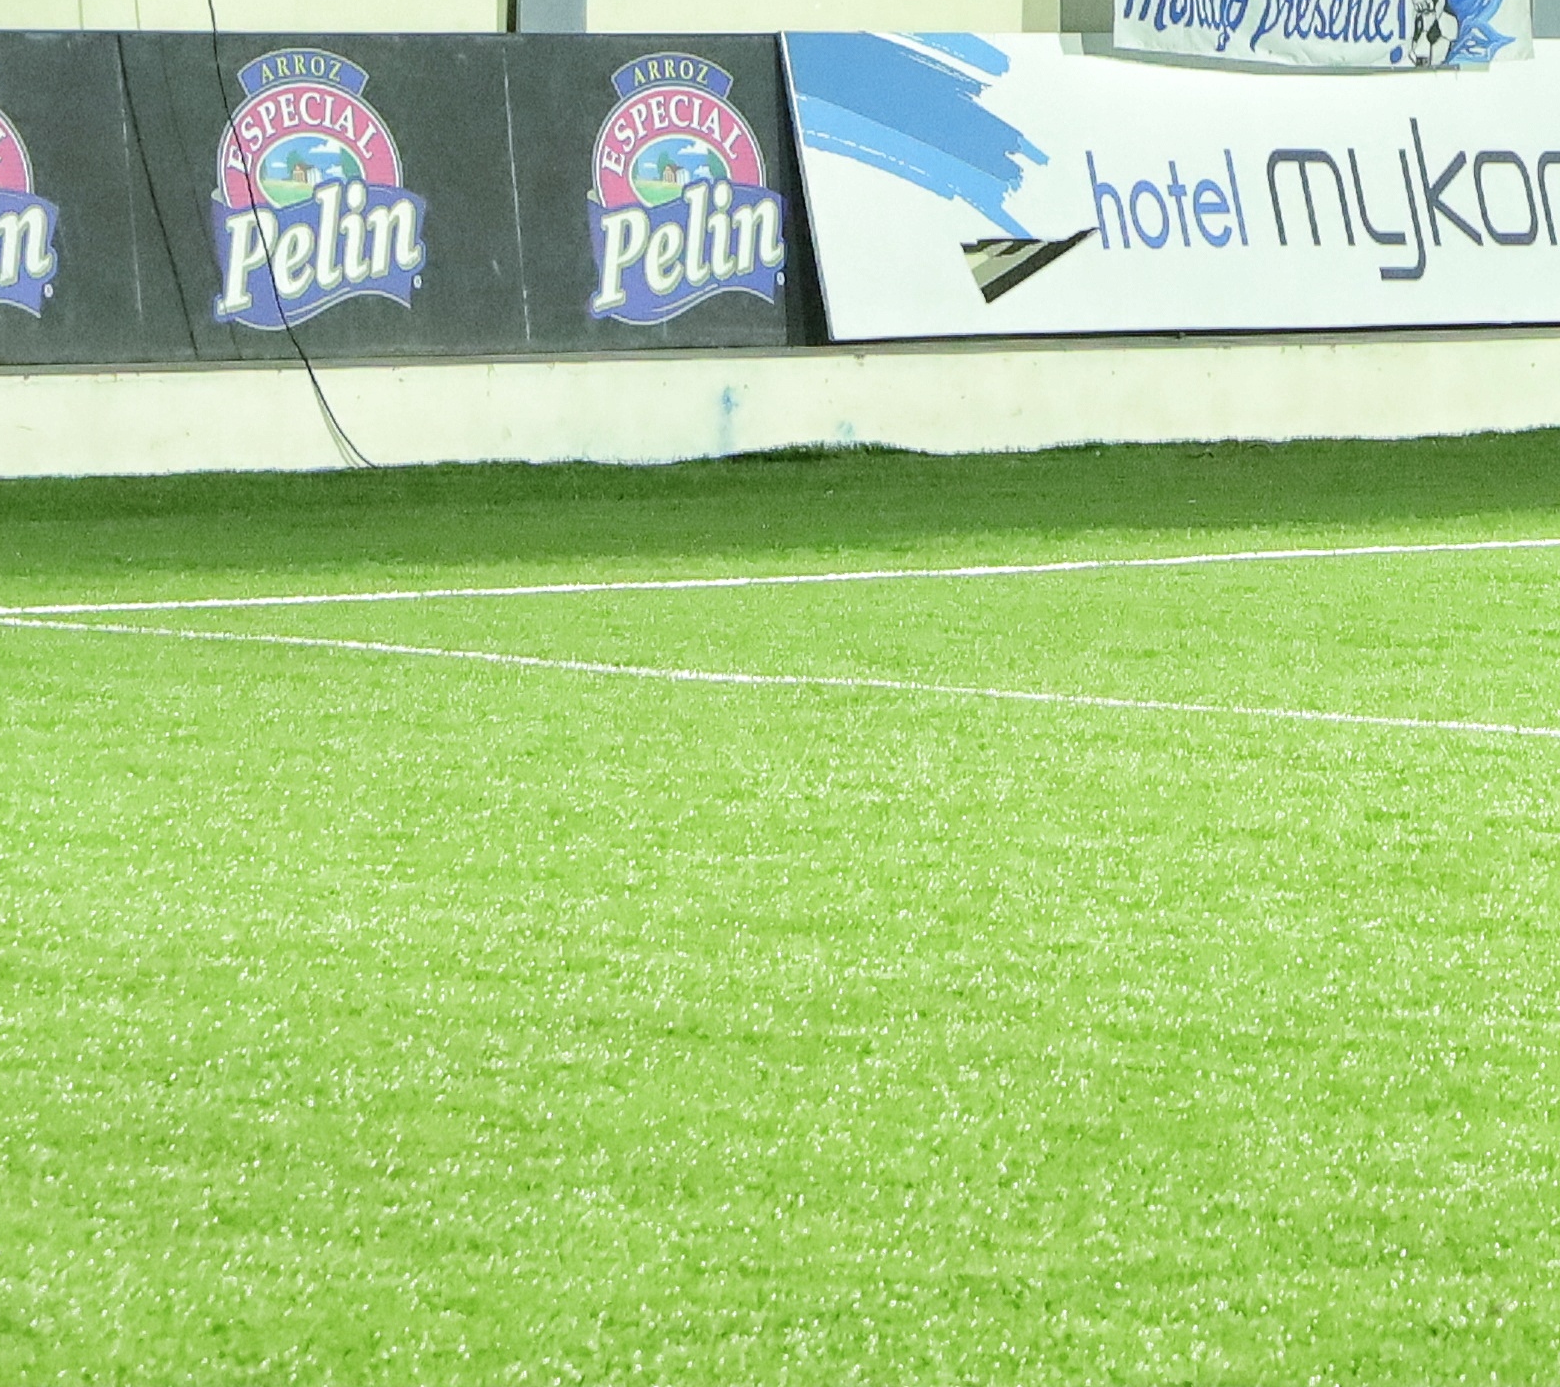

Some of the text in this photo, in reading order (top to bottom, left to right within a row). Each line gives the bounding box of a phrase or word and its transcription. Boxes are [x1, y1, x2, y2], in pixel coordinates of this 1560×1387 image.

[260, 56, 344, 83] ARROZ
[632, 58, 710, 88] ARROZ
[226, 93, 375, 177] ESPECIAL
[600, 95, 742, 177] ESPECIAL
[1085, 149, 1249, 250] hotel
[216, 179, 425, 316] Pelin
[593, 181, 785, 316] Pelin
